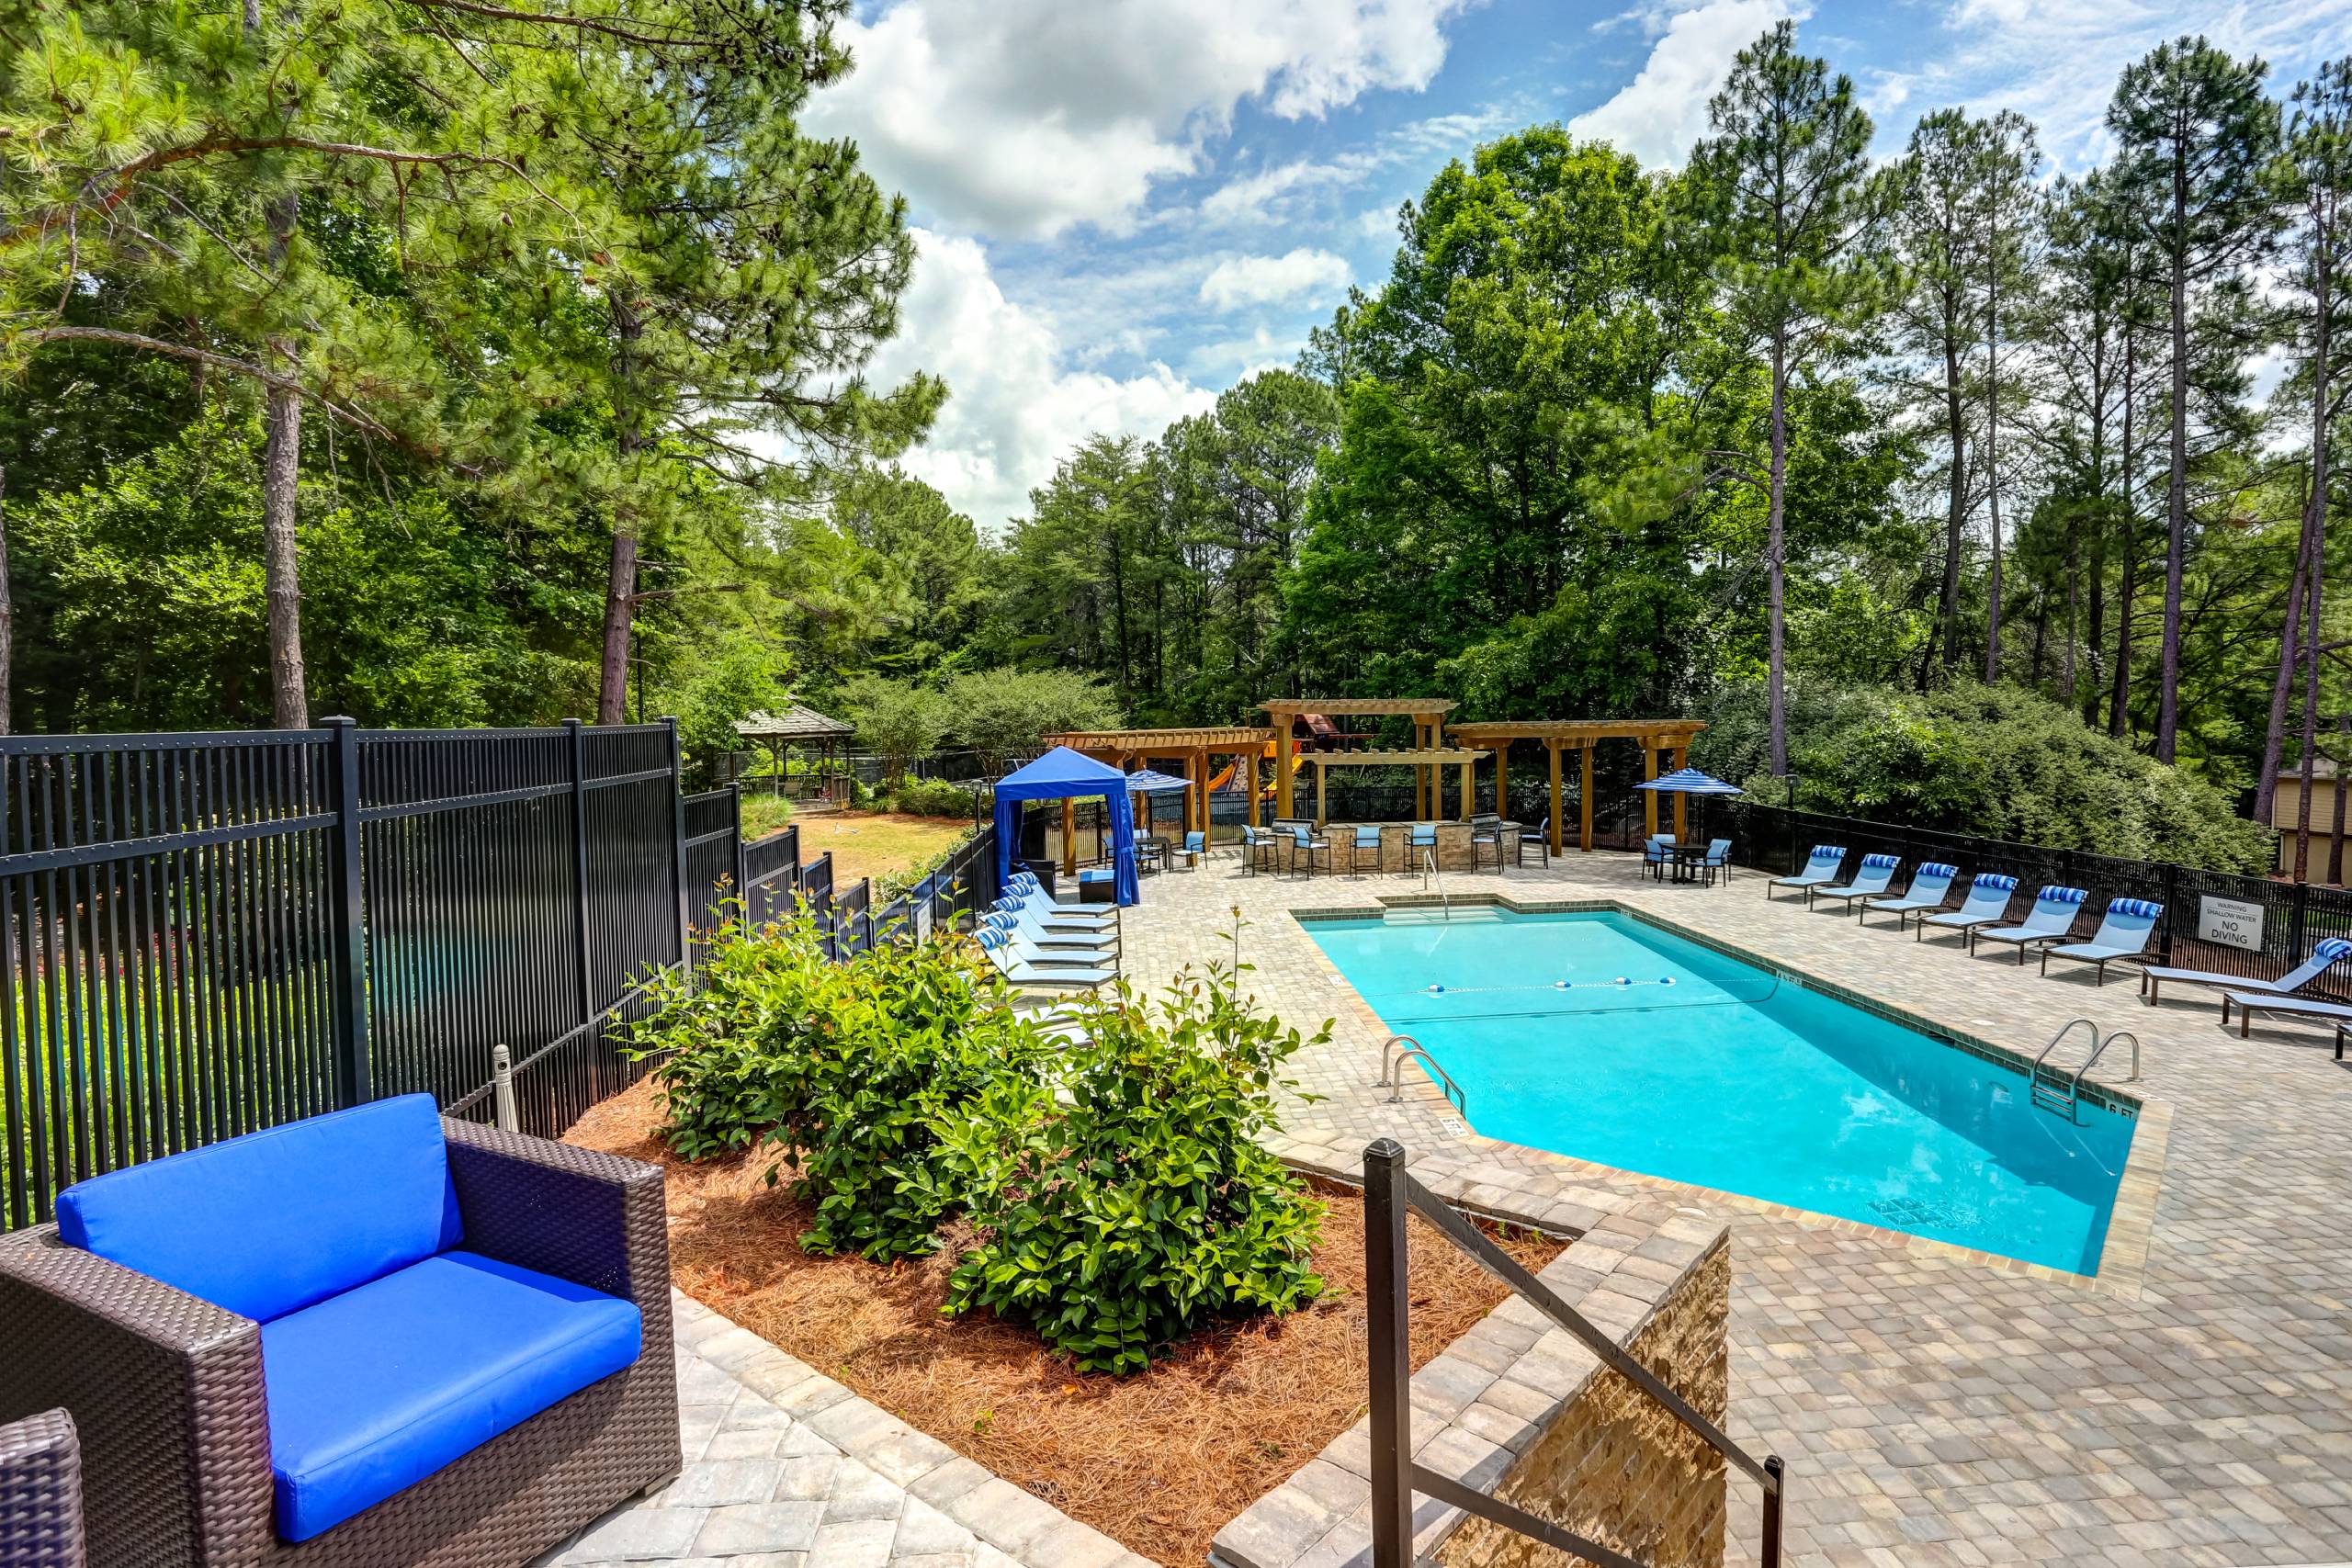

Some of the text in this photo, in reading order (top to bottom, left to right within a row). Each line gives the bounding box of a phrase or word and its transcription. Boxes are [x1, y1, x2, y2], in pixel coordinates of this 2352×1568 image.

[2217, 902, 2247, 912] WARNING
[2207, 908, 2256, 923] SHALLOW WATER
[2222, 920, 2239, 931] NO
[2211, 929, 2248, 944] DIVING
[2109, 1103, 2133, 1120] 6 FT
